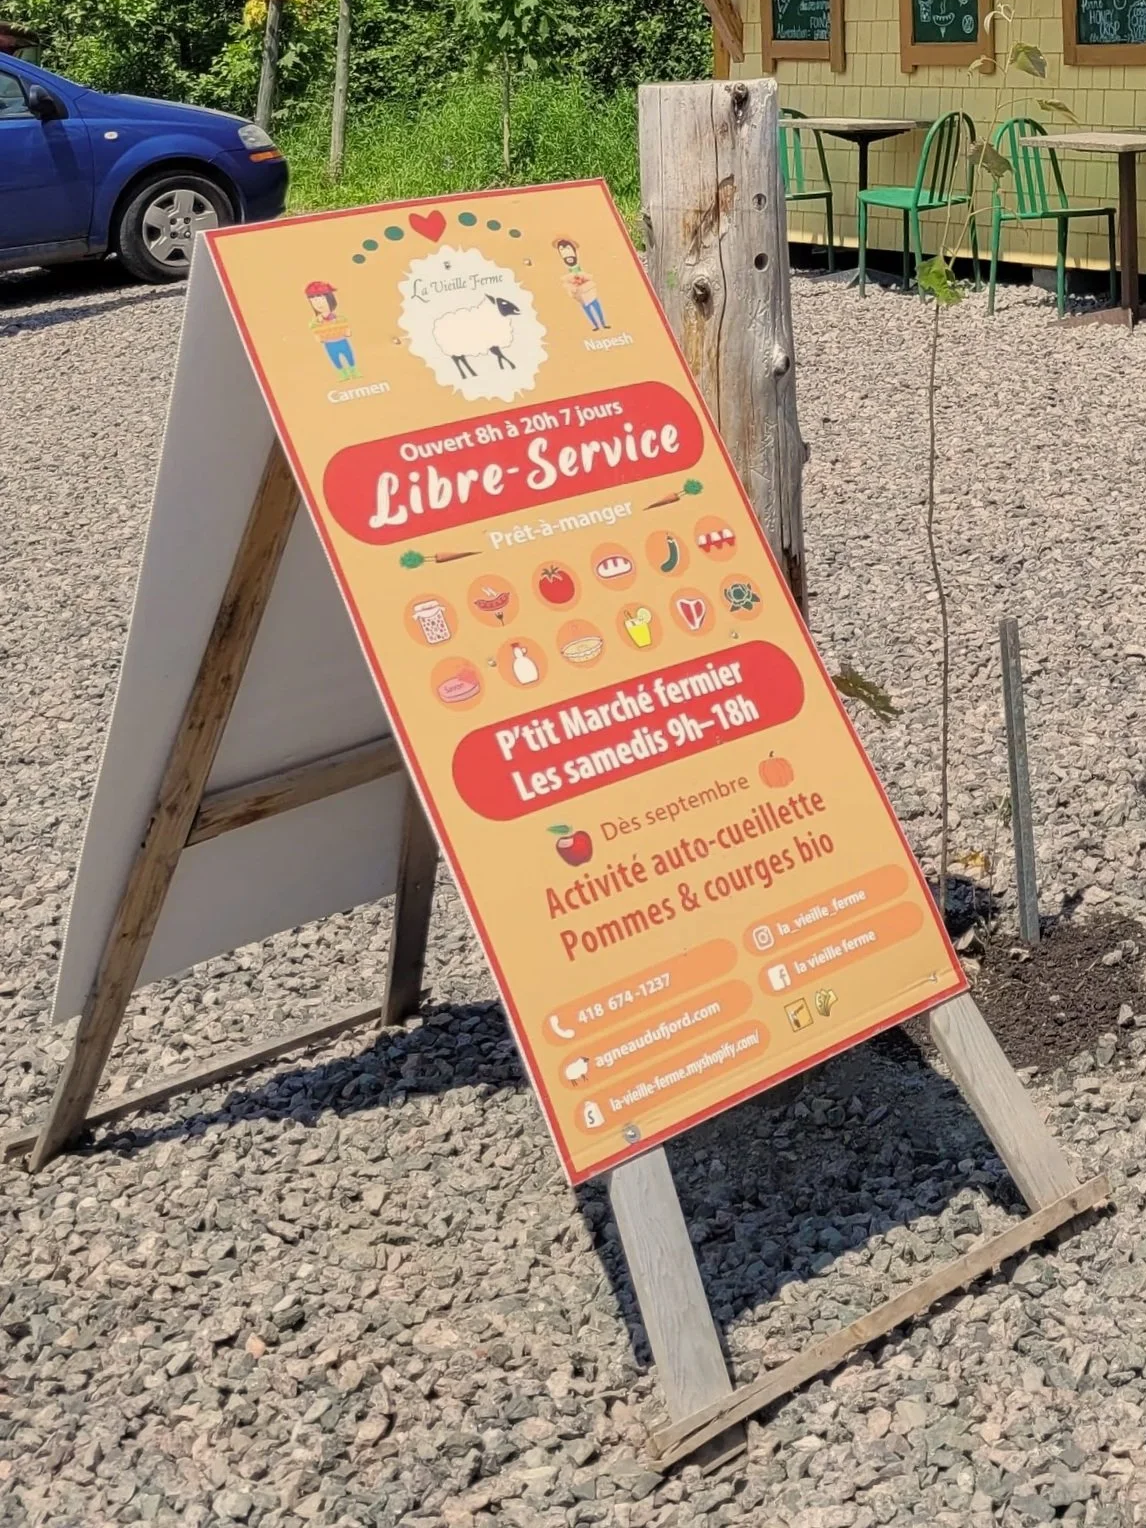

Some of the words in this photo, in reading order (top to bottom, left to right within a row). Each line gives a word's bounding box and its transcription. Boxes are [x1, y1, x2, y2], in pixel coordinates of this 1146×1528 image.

[411, 278, 429, 303] La
[431, 277, 468, 294] Vieille
[471, 273, 503, 290] Ferme
[584, 331, 633, 352] Napesh
[327, 380, 390, 404] Carmen
[400, 432, 473, 462] Ouvert
[475, 424, 502, 446] 8h
[505, 420, 520, 438] à
[523, 412, 559, 435] 20h
[560, 409, 573, 426] 7
[576, 401, 623, 428] jours
[368, 421, 681, 529] Libre-Service
[489, 500, 634, 549] Prêt-à-manger
[495, 719, 561, 761] P'tit
[559, 684, 655, 739] Marché
[654, 662, 743, 707] fermier
[512, 766, 562, 801] Les
[564, 726, 669, 784] samedis
[600, 816, 642, 842] Dès
[645, 775, 750, 826] septembre
[546, 854, 649, 919] Activité
[651, 791, 827, 876] auto-cueillette
[560, 897, 677, 962] Pommes
[677, 882, 702, 912] &
[703, 846, 796, 902] courges
[794, 830, 835, 864] bio
[776, 890, 867, 936] la_vieille_ferme
[794, 961, 808, 974] la
[808, 946, 843, 968] vieille
[842, 930, 877, 952] ferme
[578, 1003, 605, 1024] 418
[594, 1001, 721, 1068] agneaudufjord.com
